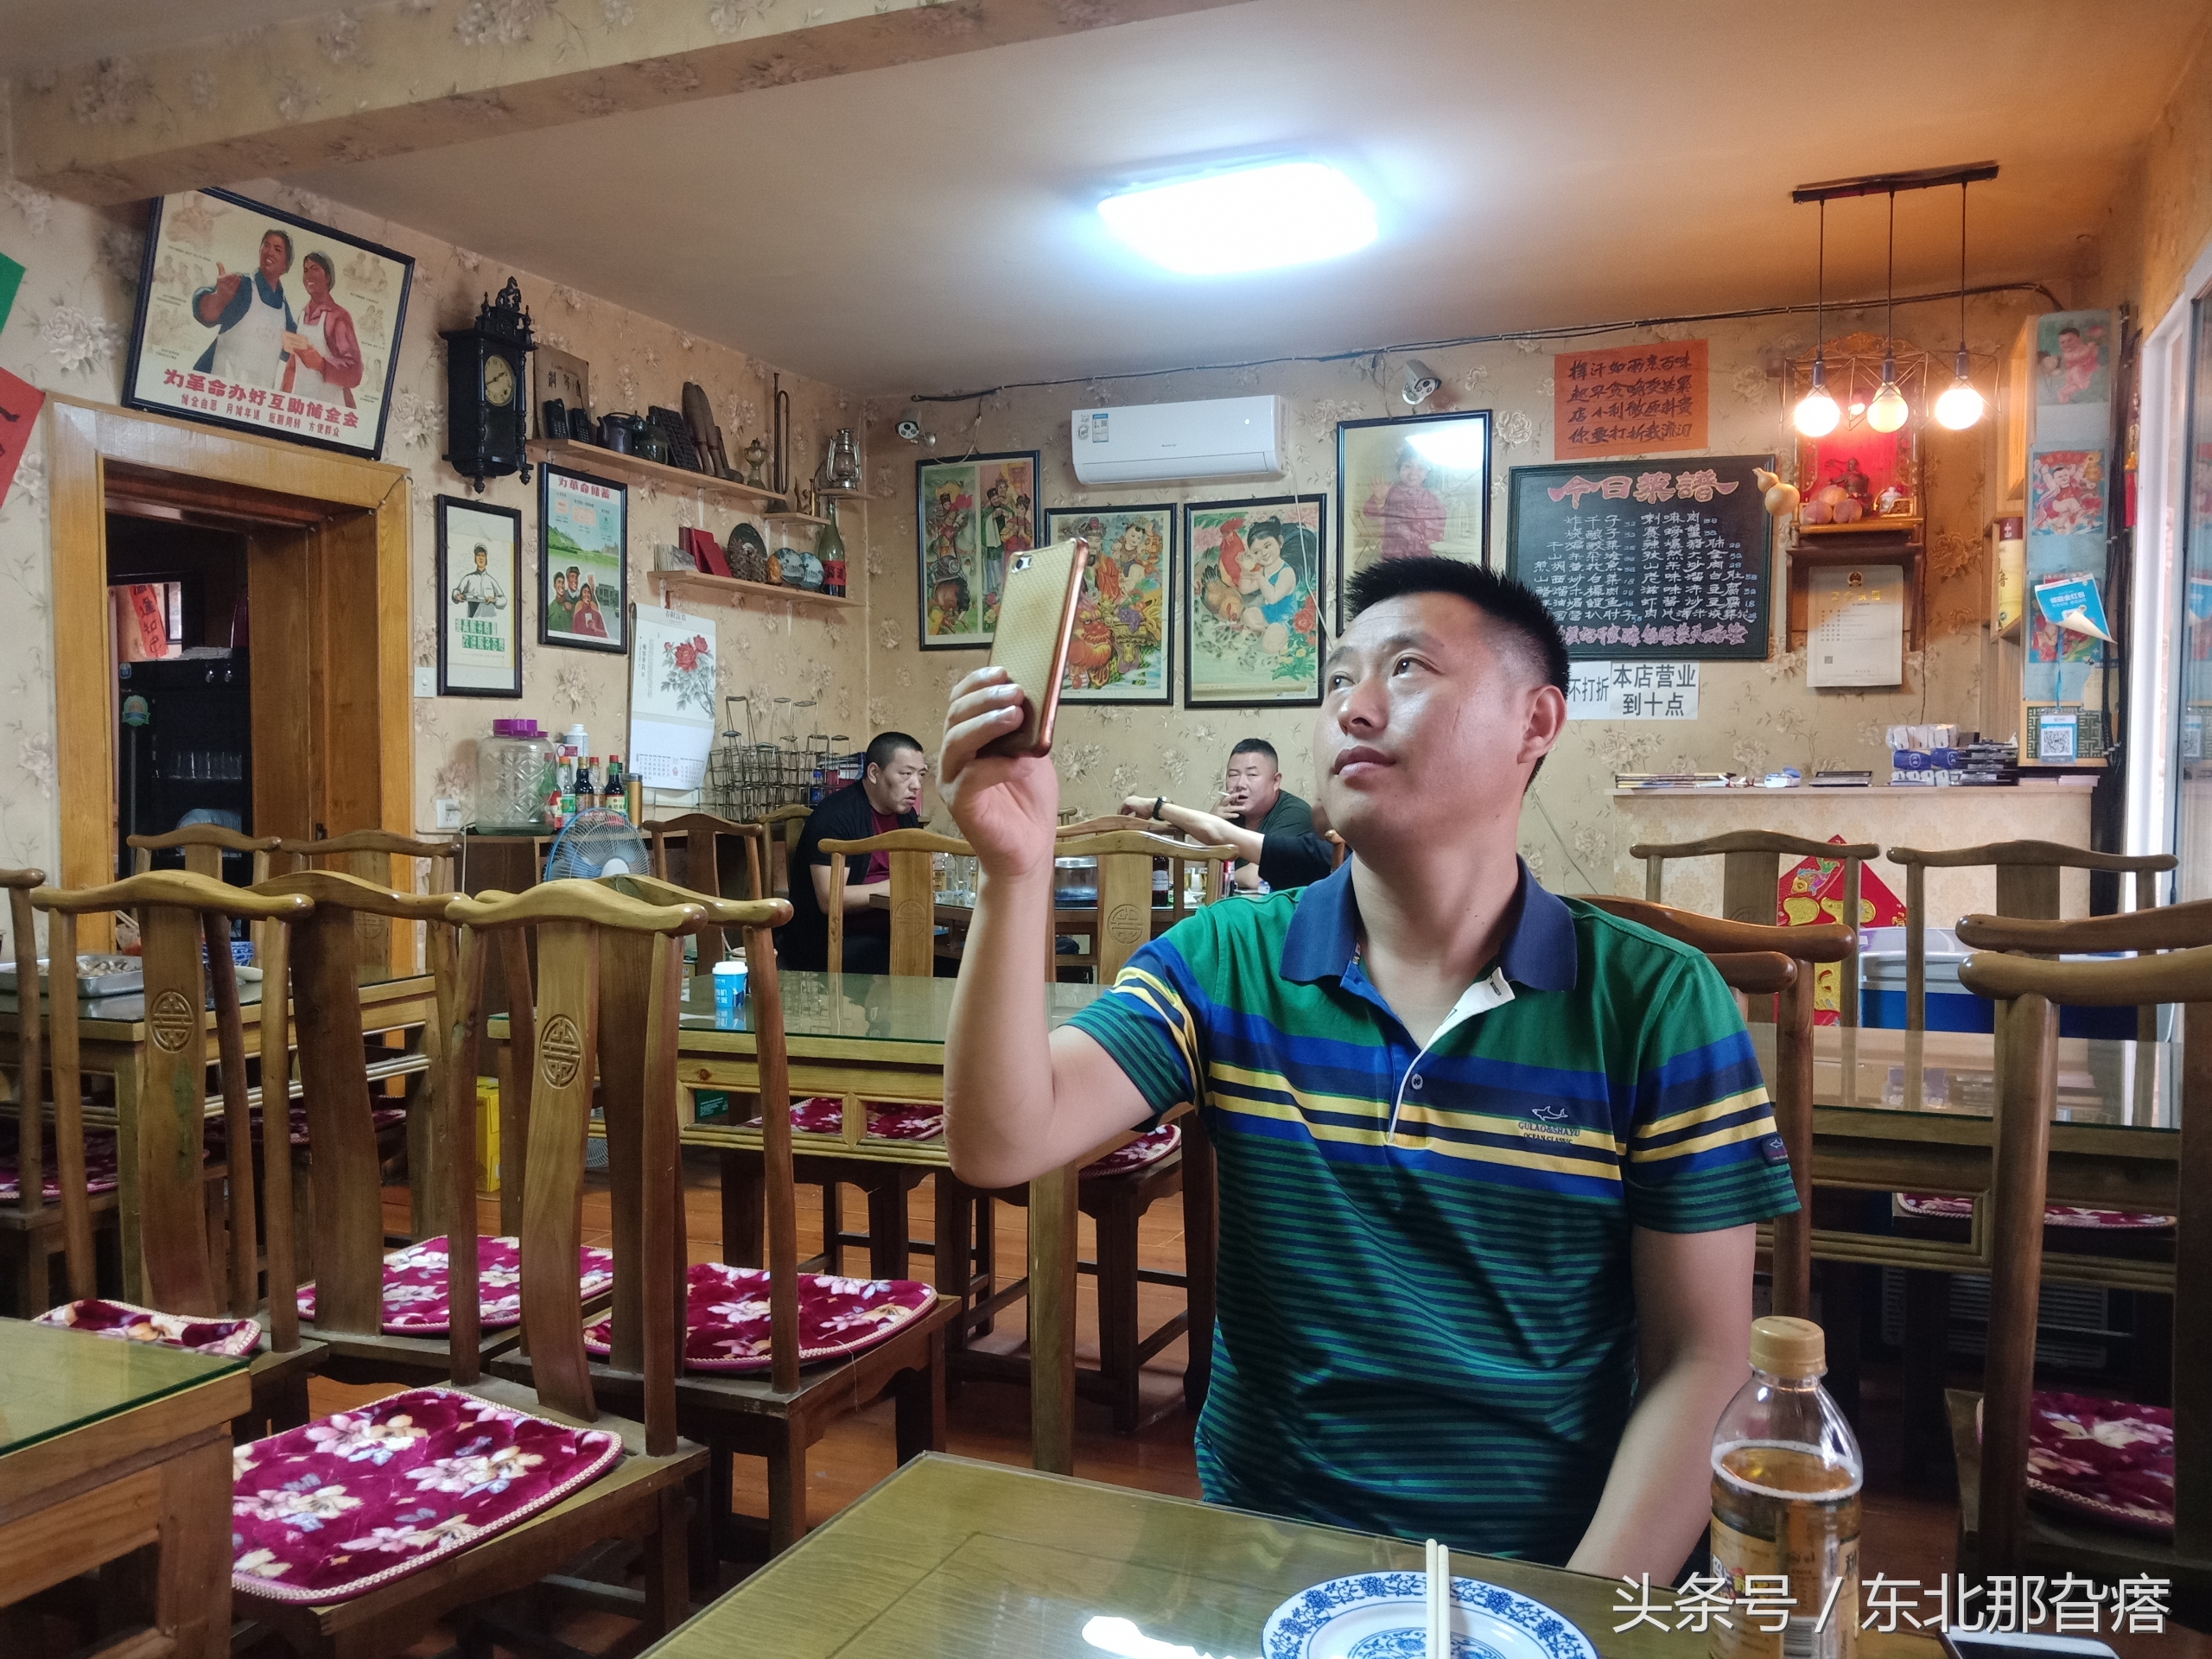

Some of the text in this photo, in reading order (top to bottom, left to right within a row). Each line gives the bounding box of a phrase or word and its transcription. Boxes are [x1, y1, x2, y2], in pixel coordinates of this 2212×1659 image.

[163, 369, 359, 429] 为革命办好互助储金会
[308, 421, 340, 438] 方便群众
[558, 476, 610, 499] 为革命储蓄
[1534, 572, 1621, 588] 山西炒白菜
[1613, 664, 1696, 689] 本店营业
[1568, 676, 1609, 702] 不打折
[1623, 691, 1684, 716] 到十点
[1518, 1122, 1580, 1137] GULAO&SHAYU
[1523, 1132, 1573, 1145] OCEAN CLASSIC
